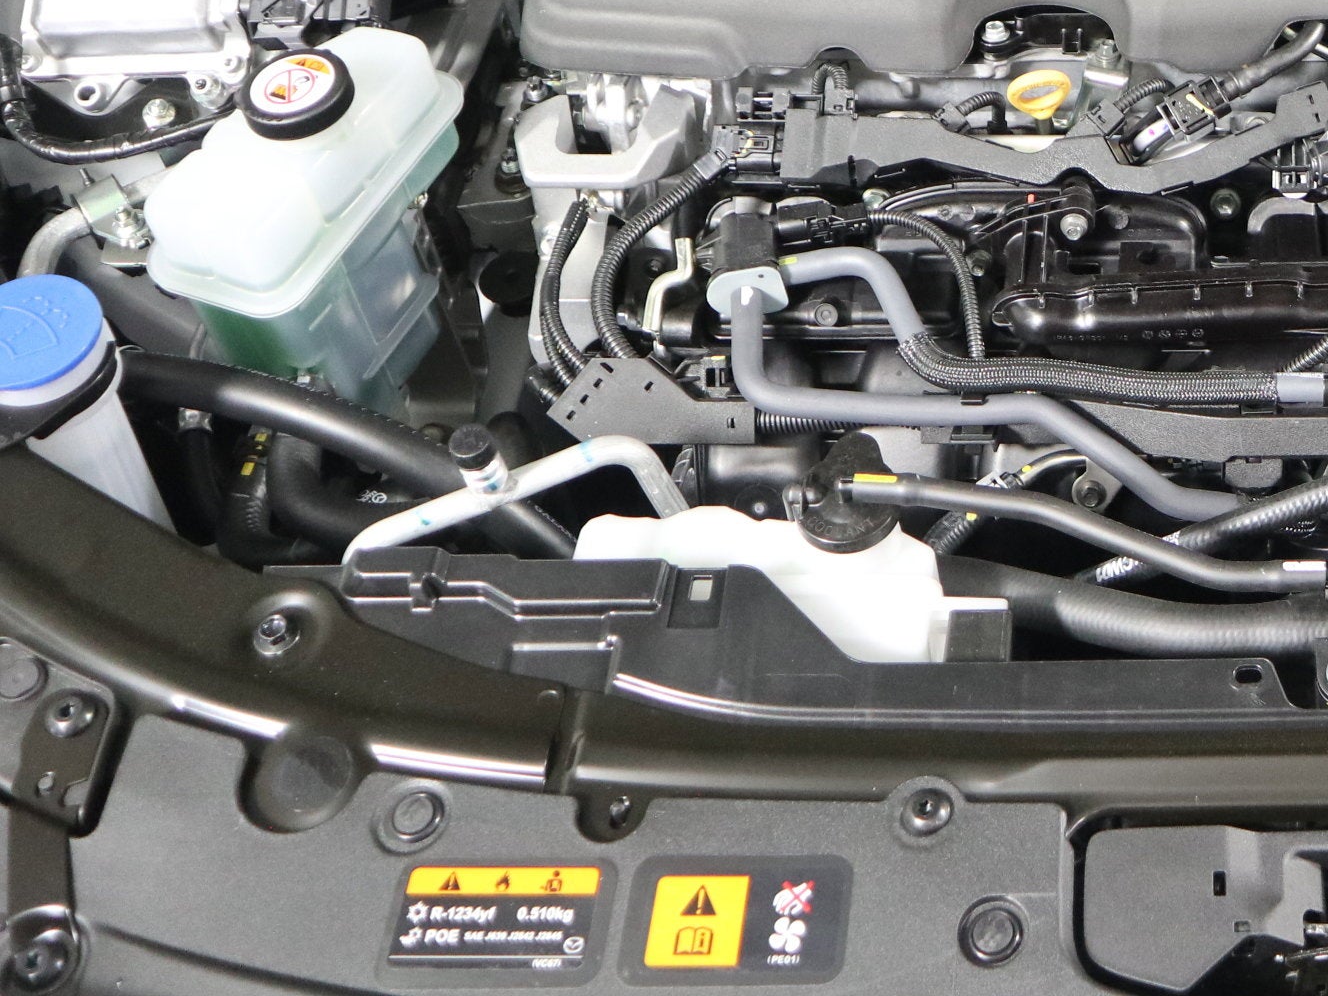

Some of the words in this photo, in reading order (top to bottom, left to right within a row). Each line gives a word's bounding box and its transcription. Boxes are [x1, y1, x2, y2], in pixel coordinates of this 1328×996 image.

[807, 515, 875, 538] COOLANT
[429, 906, 497, 925] R-1234yf
[516, 906, 575, 925] 0.510kg
[424, 928, 461, 945] POE
[766, 954, 801, 965] (PE01)
